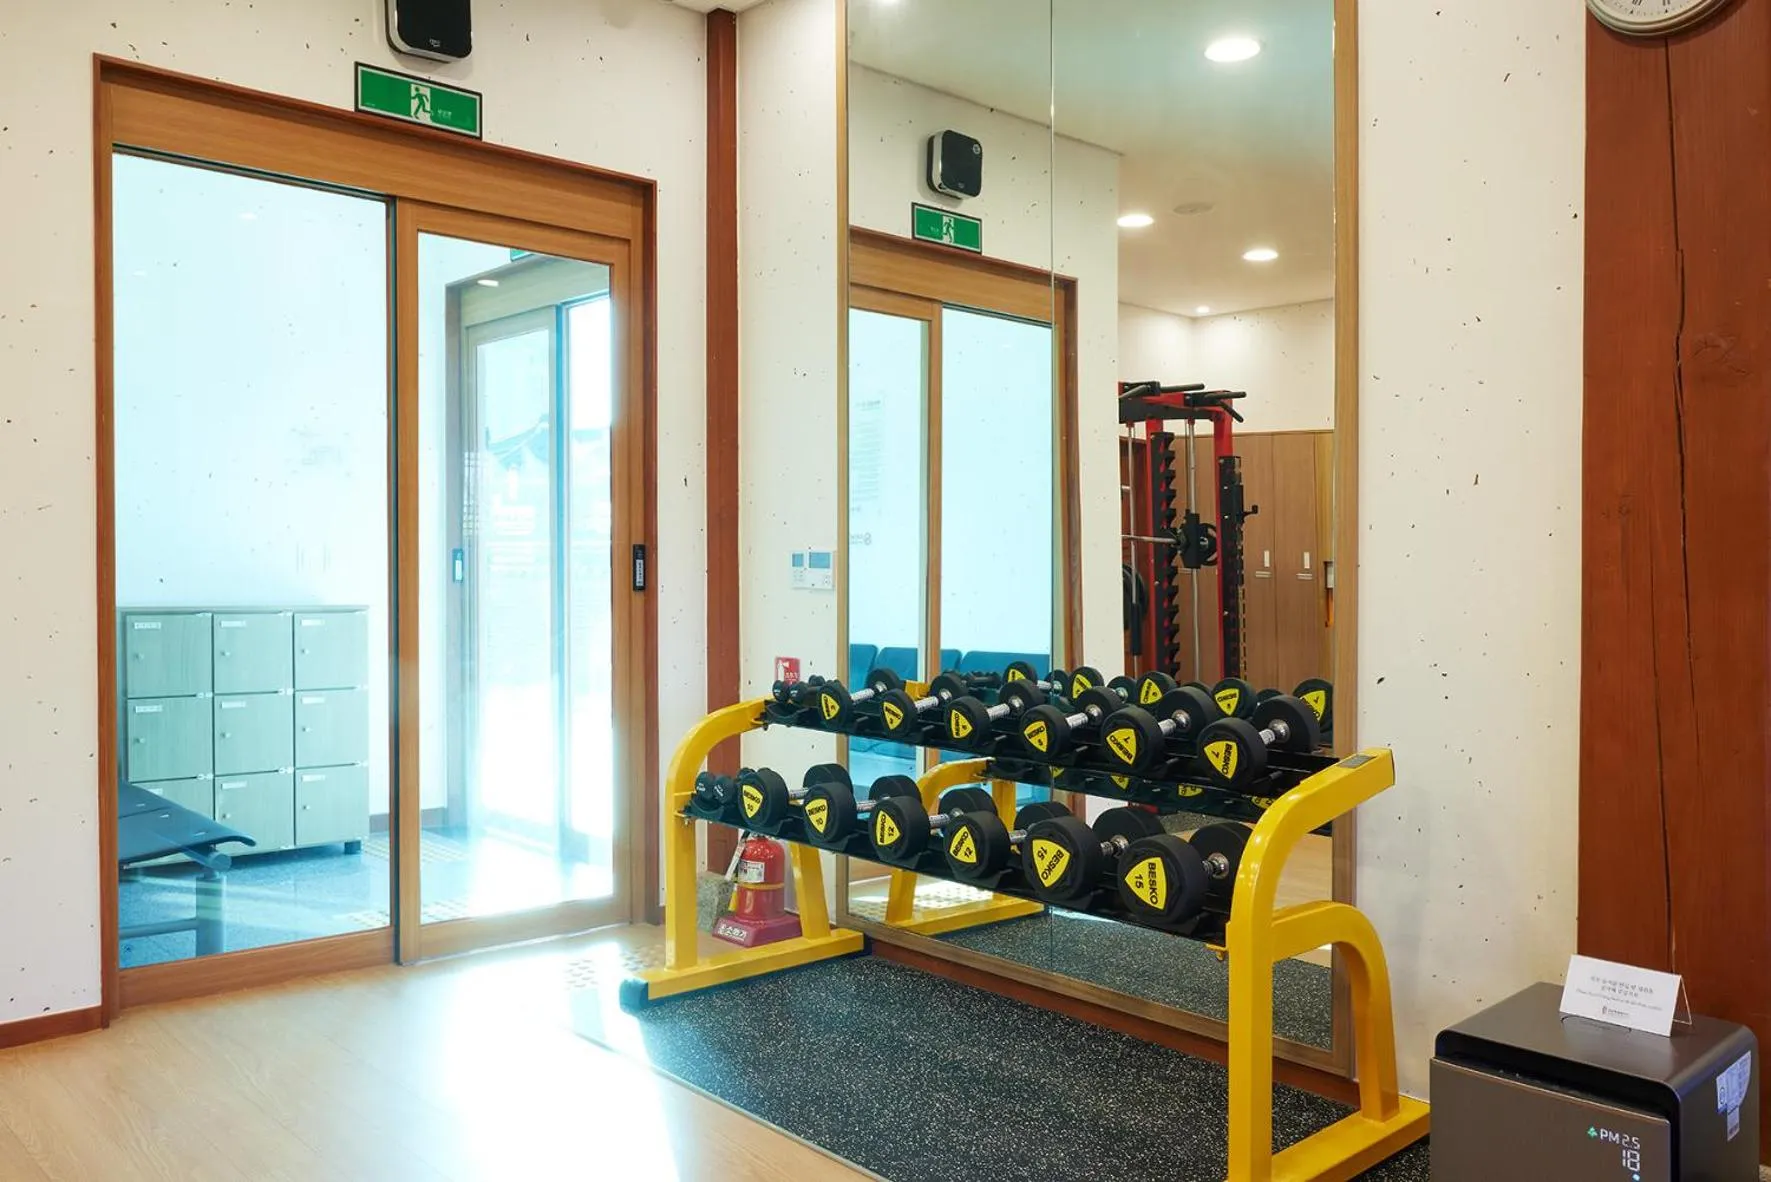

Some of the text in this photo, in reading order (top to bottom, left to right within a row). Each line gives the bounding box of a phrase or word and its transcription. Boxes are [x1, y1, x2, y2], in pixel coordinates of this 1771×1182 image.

[964, 847, 973, 859] 12
[1037, 846, 1047, 861] 15
[1040, 849, 1065, 881] BESKO
[1134, 873, 1144, 889] 15
[1147, 862, 1159, 905] BESKO
[1600, 1127, 1620, 1144] PM
[1622, 1150, 1641, 1172] 18
